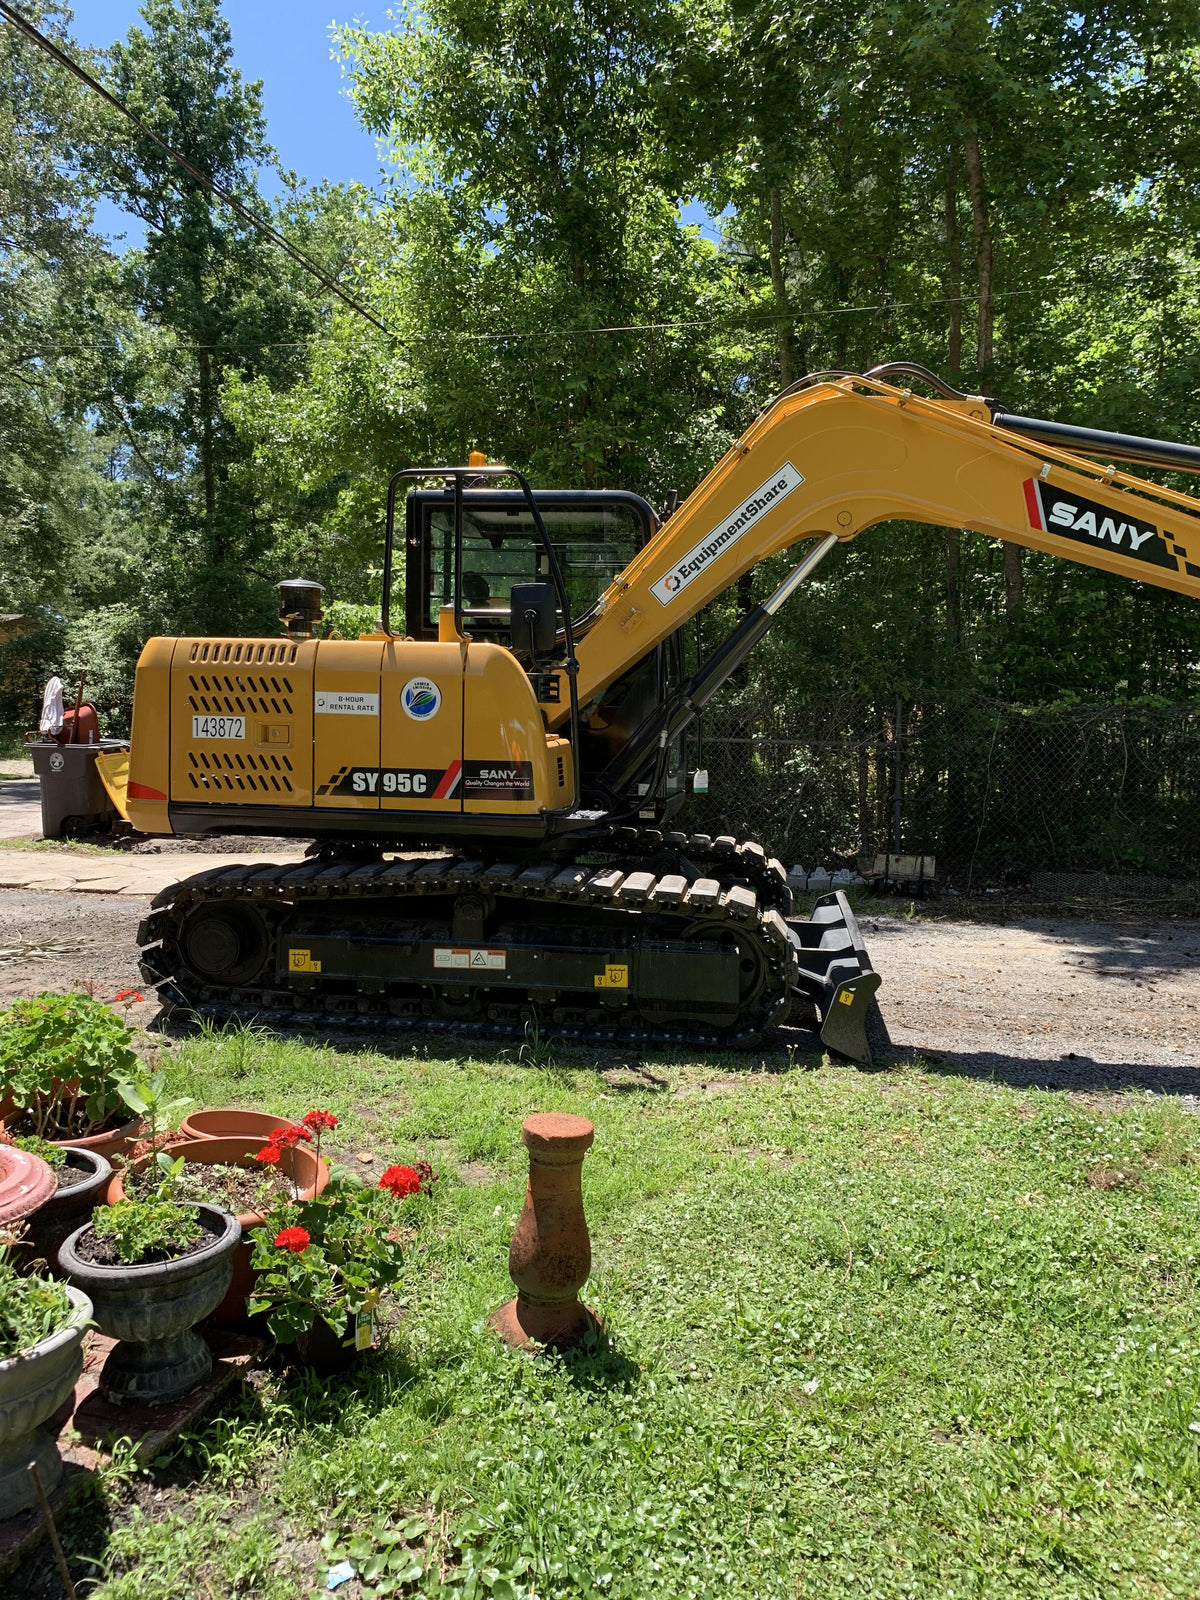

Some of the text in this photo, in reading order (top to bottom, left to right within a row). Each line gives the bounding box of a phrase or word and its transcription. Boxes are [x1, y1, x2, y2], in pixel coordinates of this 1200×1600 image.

[677, 478, 788, 580] EquipmentShare
[1048, 501, 1155, 551] SANY
[338, 695, 364, 703] 8-HOUR
[329, 703, 375, 712] RENTAL RATE
[194, 717, 243, 738] 143872
[479, 769, 517, 780] SANY
[464, 779, 483, 787] Quality
[483, 779, 505, 788] Changes
